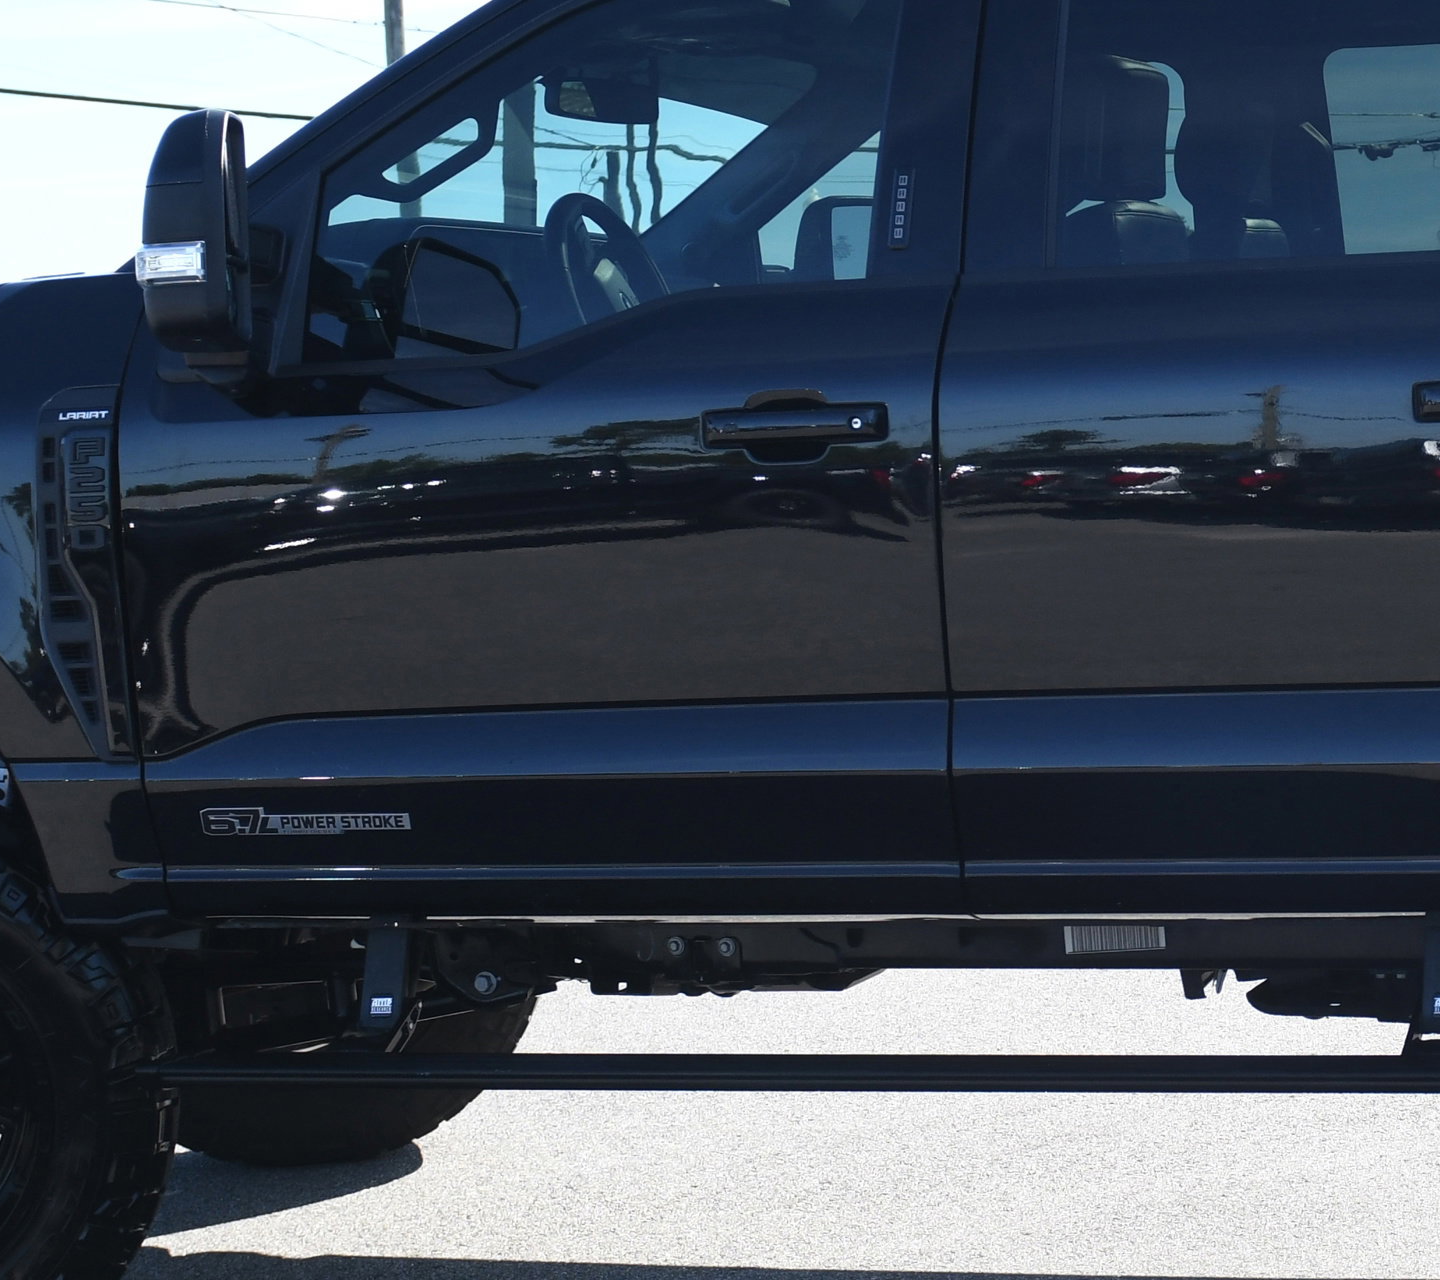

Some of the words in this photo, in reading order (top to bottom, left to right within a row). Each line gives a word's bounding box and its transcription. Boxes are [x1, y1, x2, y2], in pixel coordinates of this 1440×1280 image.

[58, 408, 109, 422] LARIAT
[69, 436, 107, 550] F250
[199, 806, 278, 837] 6.7L
[280, 816, 336, 829] POWER
[341, 815, 405, 829] STROKE
